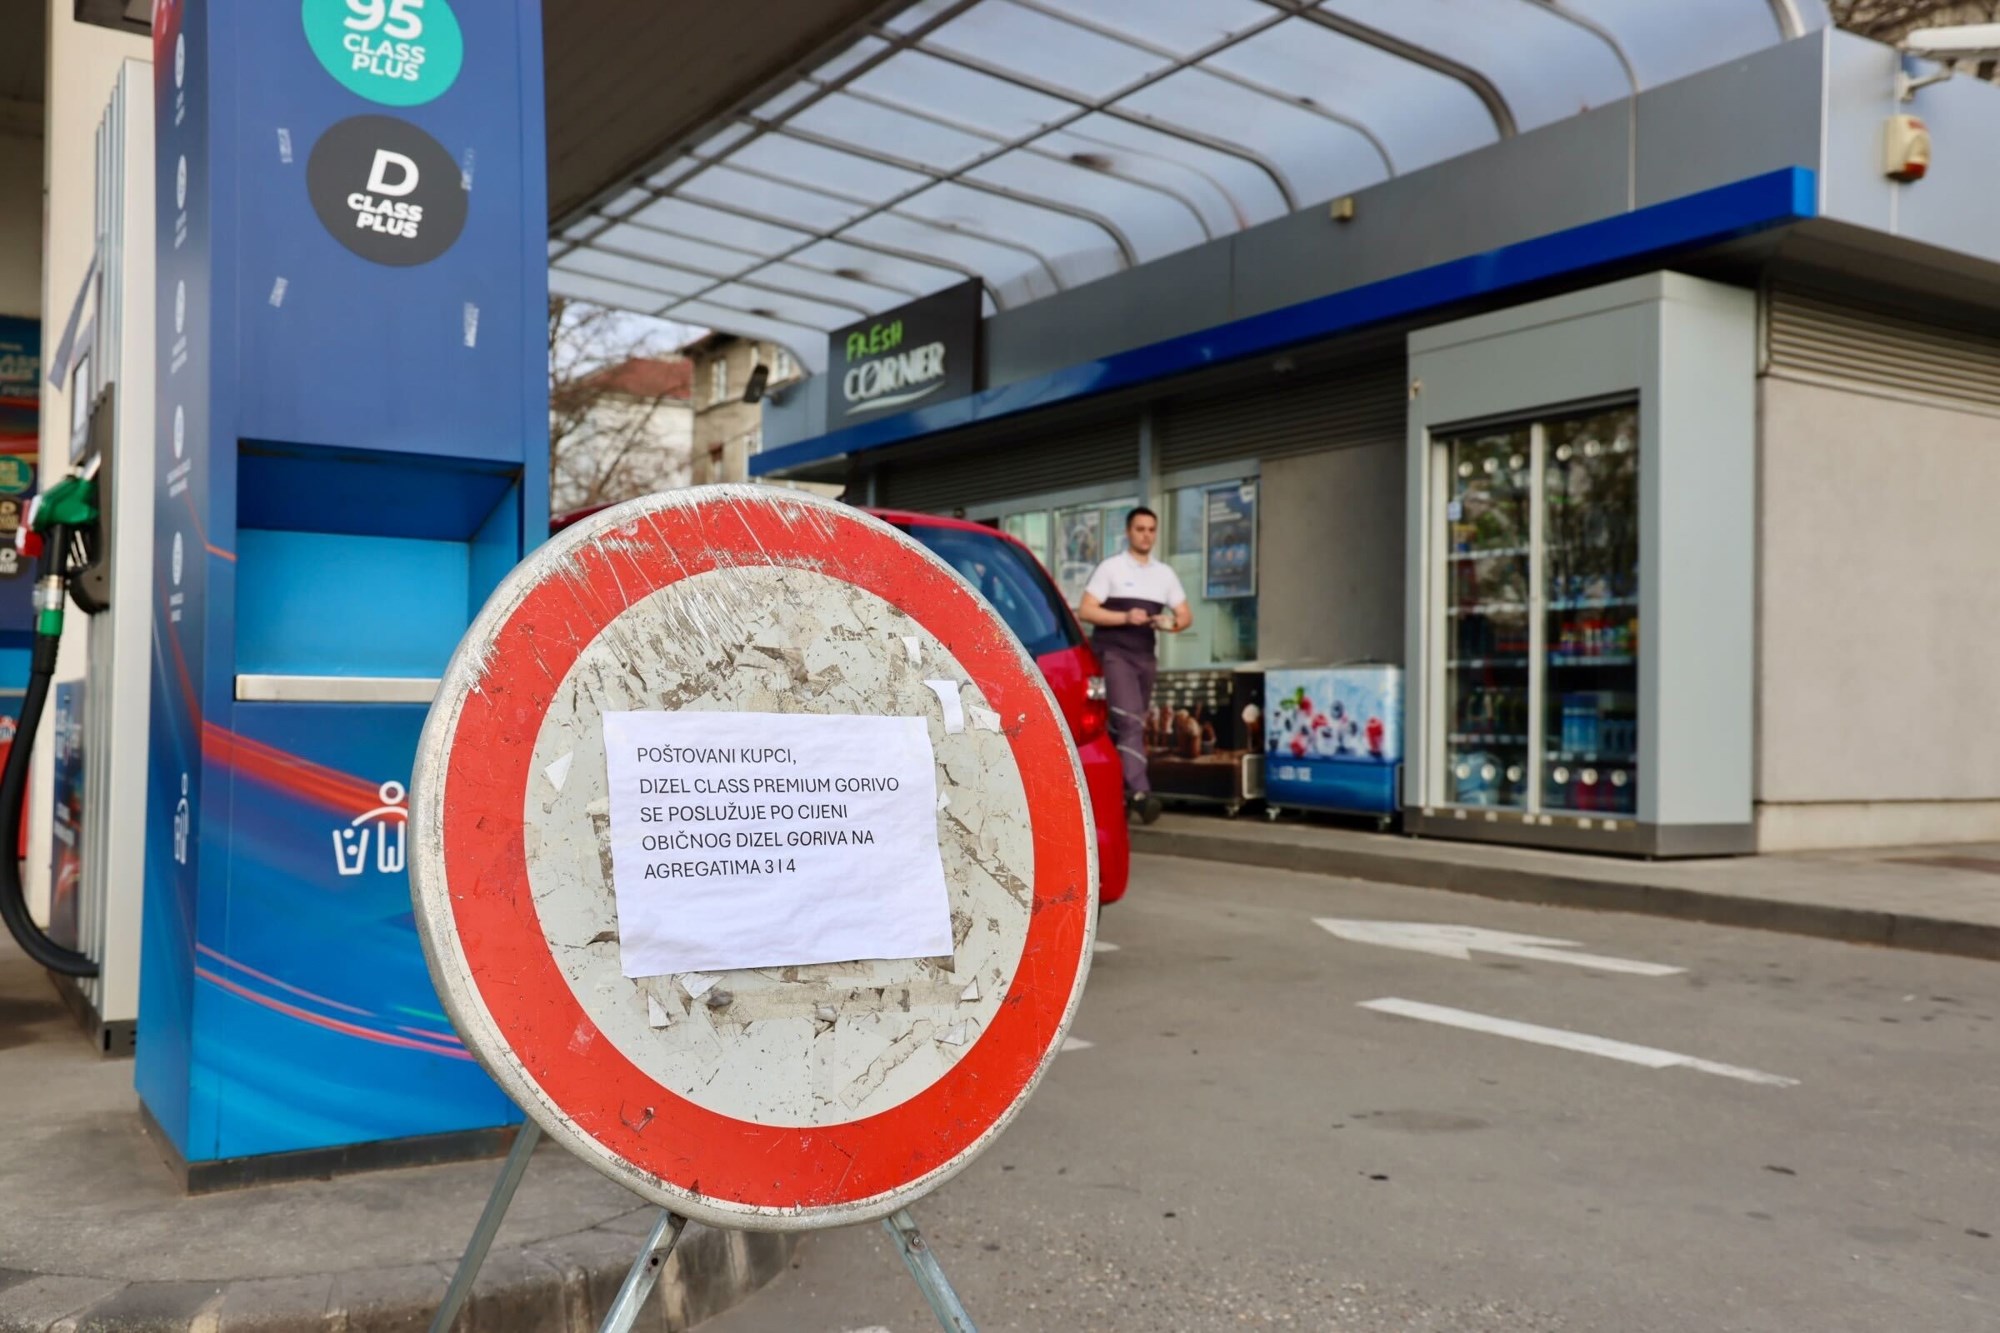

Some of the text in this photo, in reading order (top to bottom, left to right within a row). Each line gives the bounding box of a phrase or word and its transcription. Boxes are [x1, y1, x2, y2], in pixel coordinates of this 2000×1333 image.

[343, 0, 424, 40] 95
[343, 33, 426, 65] CLASS
[352, 53, 420, 82] PLUS
[366, 148, 420, 197] D
[347, 192, 424, 223] CLASS
[356, 211, 419, 239] PLUS
[846, 320, 903, 363] FRESH
[843, 341, 945, 403] CORNER
[637, 743, 798, 765] POŠTOVANI KUPCI,
[639, 777, 899, 794] DIZEL CLASS PREMIUM GORIVO
[640, 802, 848, 823] SE POSLUŽUJE PO CIJENI
[642, 830, 875, 851] OBIČNOG DIZEL GORIVA NA
[644, 860, 762, 880] AGREGATIMA
[764, 859, 774, 874] 3
[786, 858, 797, 873] 4
